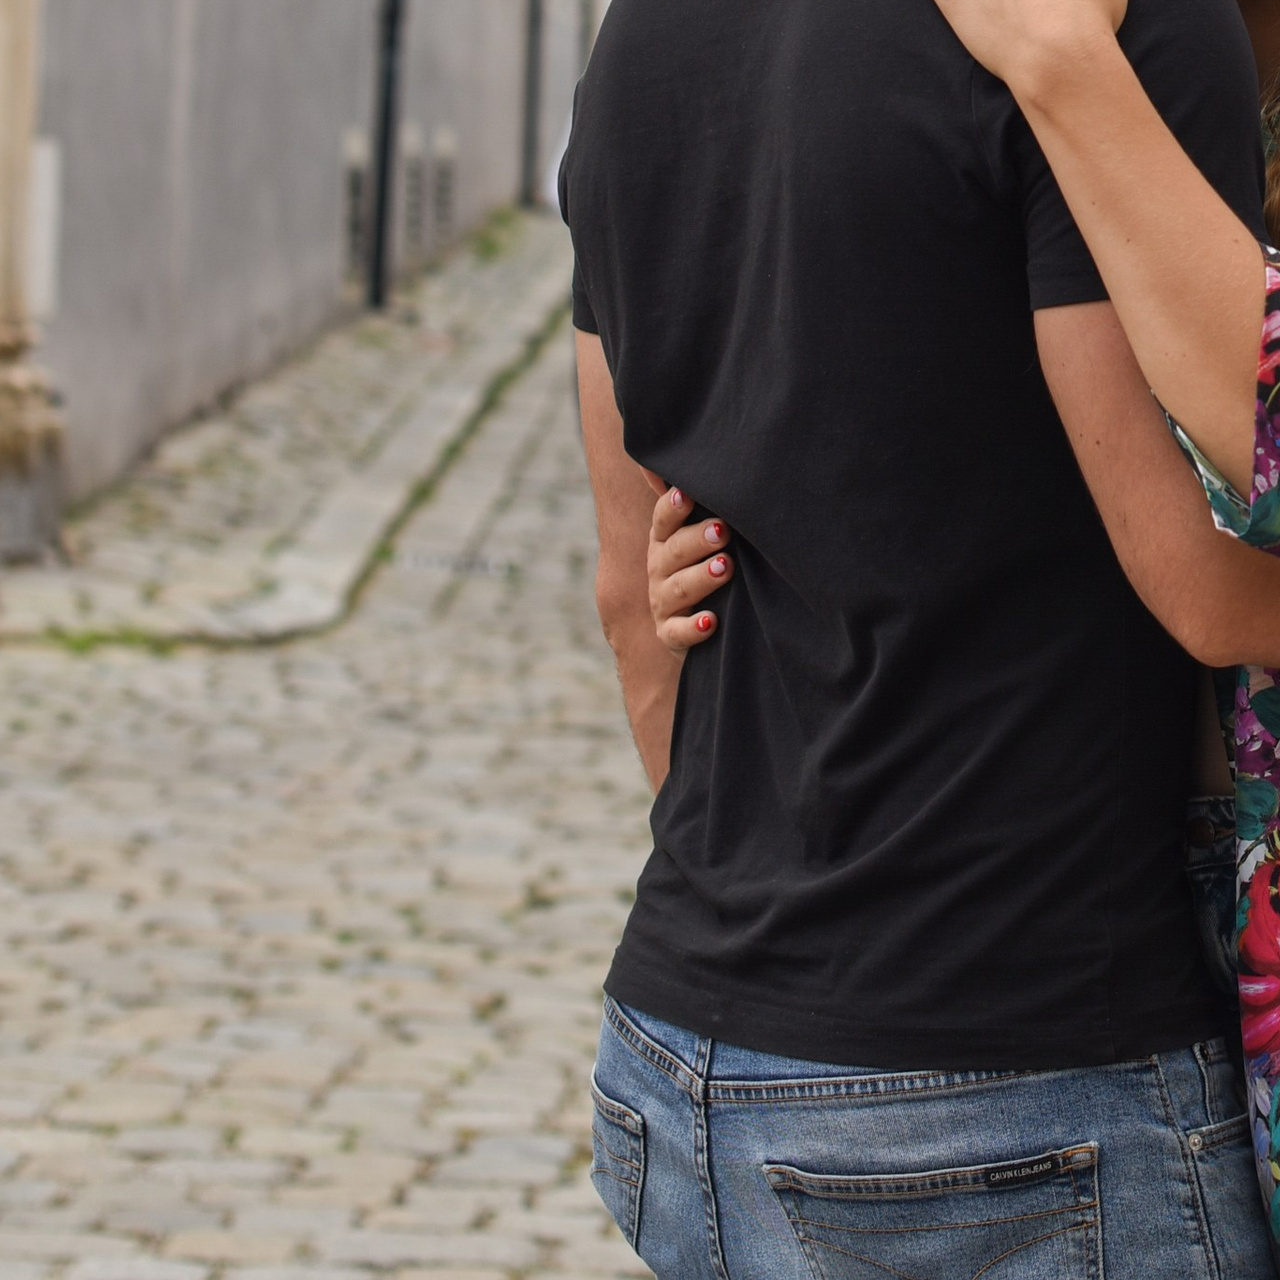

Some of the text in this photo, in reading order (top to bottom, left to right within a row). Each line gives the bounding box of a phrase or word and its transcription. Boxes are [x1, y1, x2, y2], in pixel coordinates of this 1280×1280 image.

[990, 1161, 1052, 1181] CALVIN KLEIN JEANS
